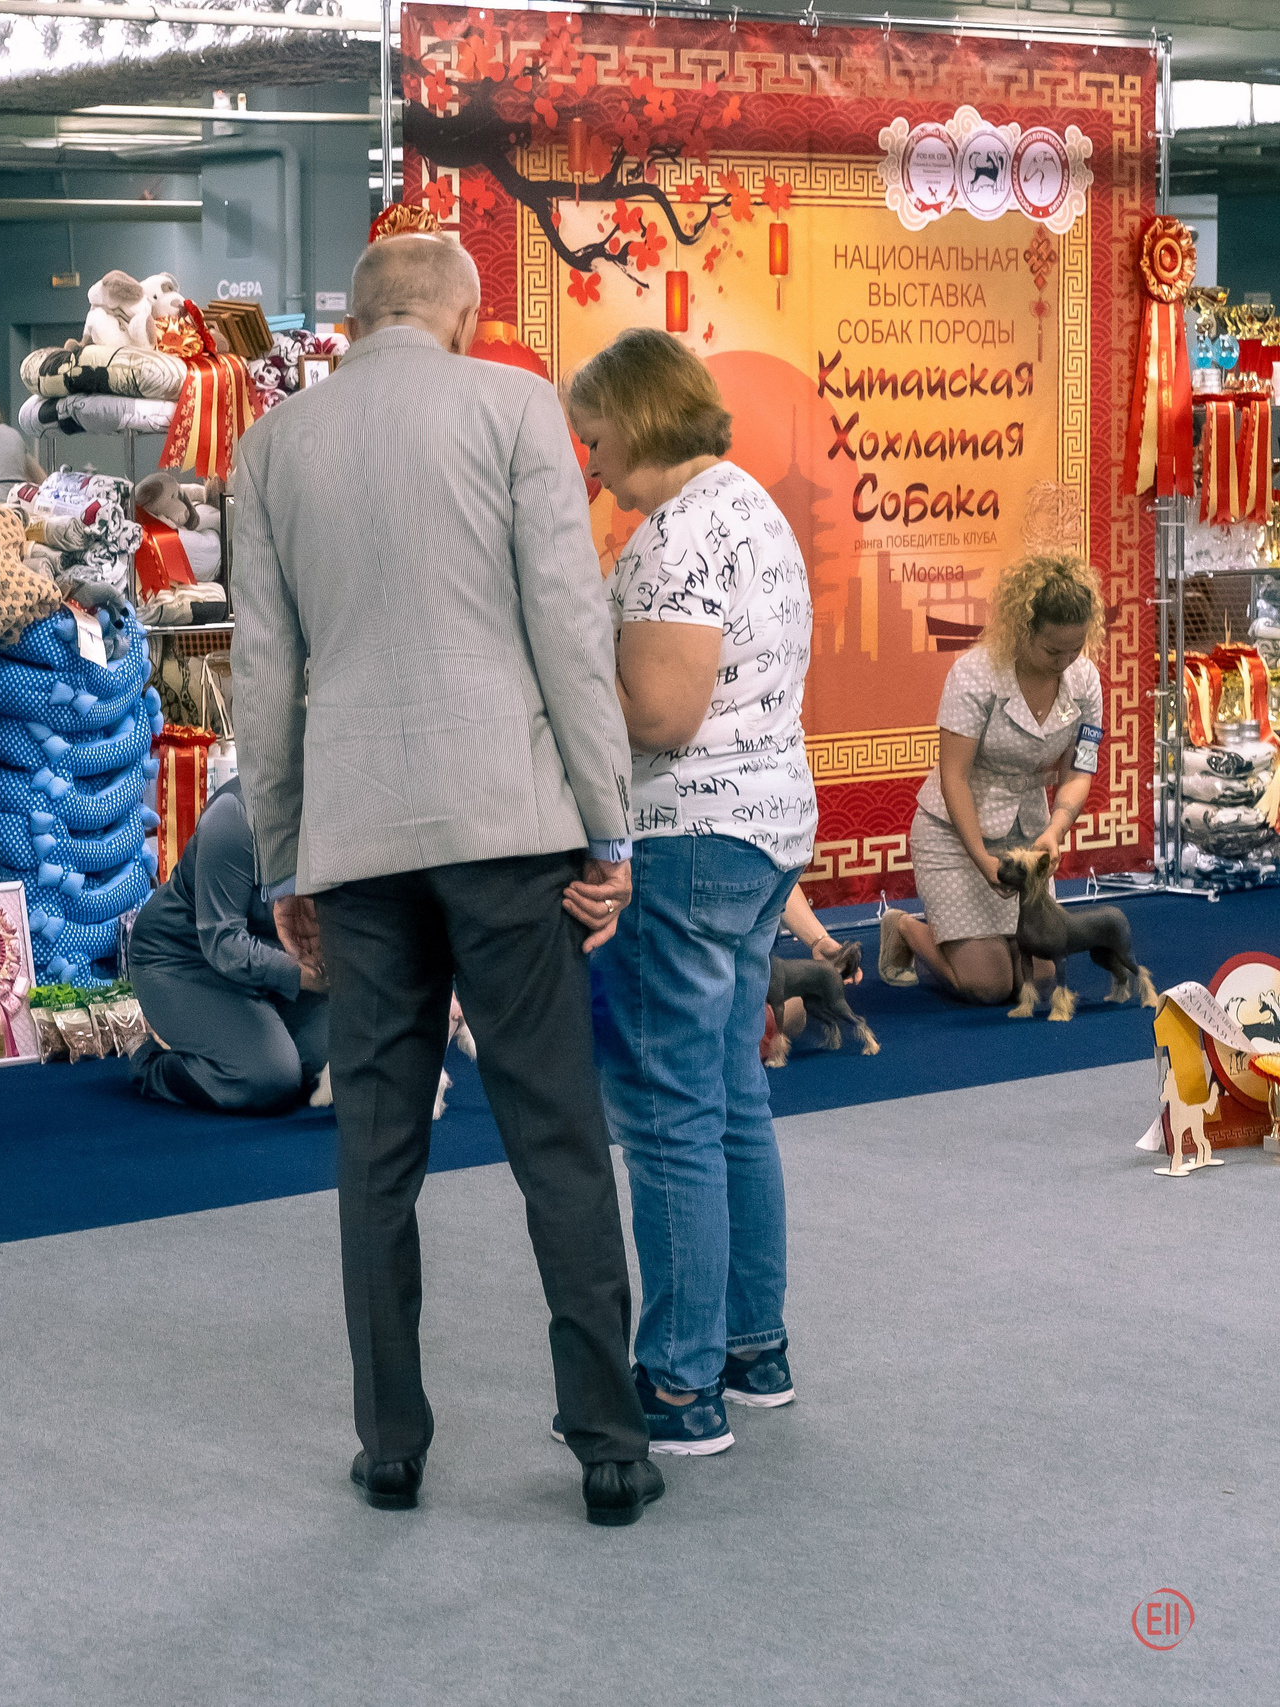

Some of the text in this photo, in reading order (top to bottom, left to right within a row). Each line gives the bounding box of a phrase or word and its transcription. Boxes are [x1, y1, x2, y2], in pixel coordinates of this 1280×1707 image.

[833, 244, 1020, 276] НАЦИОНАЛЬНАЯ
[868, 282, 987, 308] ВЫСТАВКА
[837, 318, 1015, 349] СОБАК ПОРОДЫ
[817, 350, 1035, 401] Китайская
[827, 411, 1025, 462] Хохлатая
[852, 472, 1000, 527] Собака
[854, 531, 998, 552] ранга ПОБЕДИТЕЛЬ КЛУБА
[889, 562, 965, 584] г. Москва
